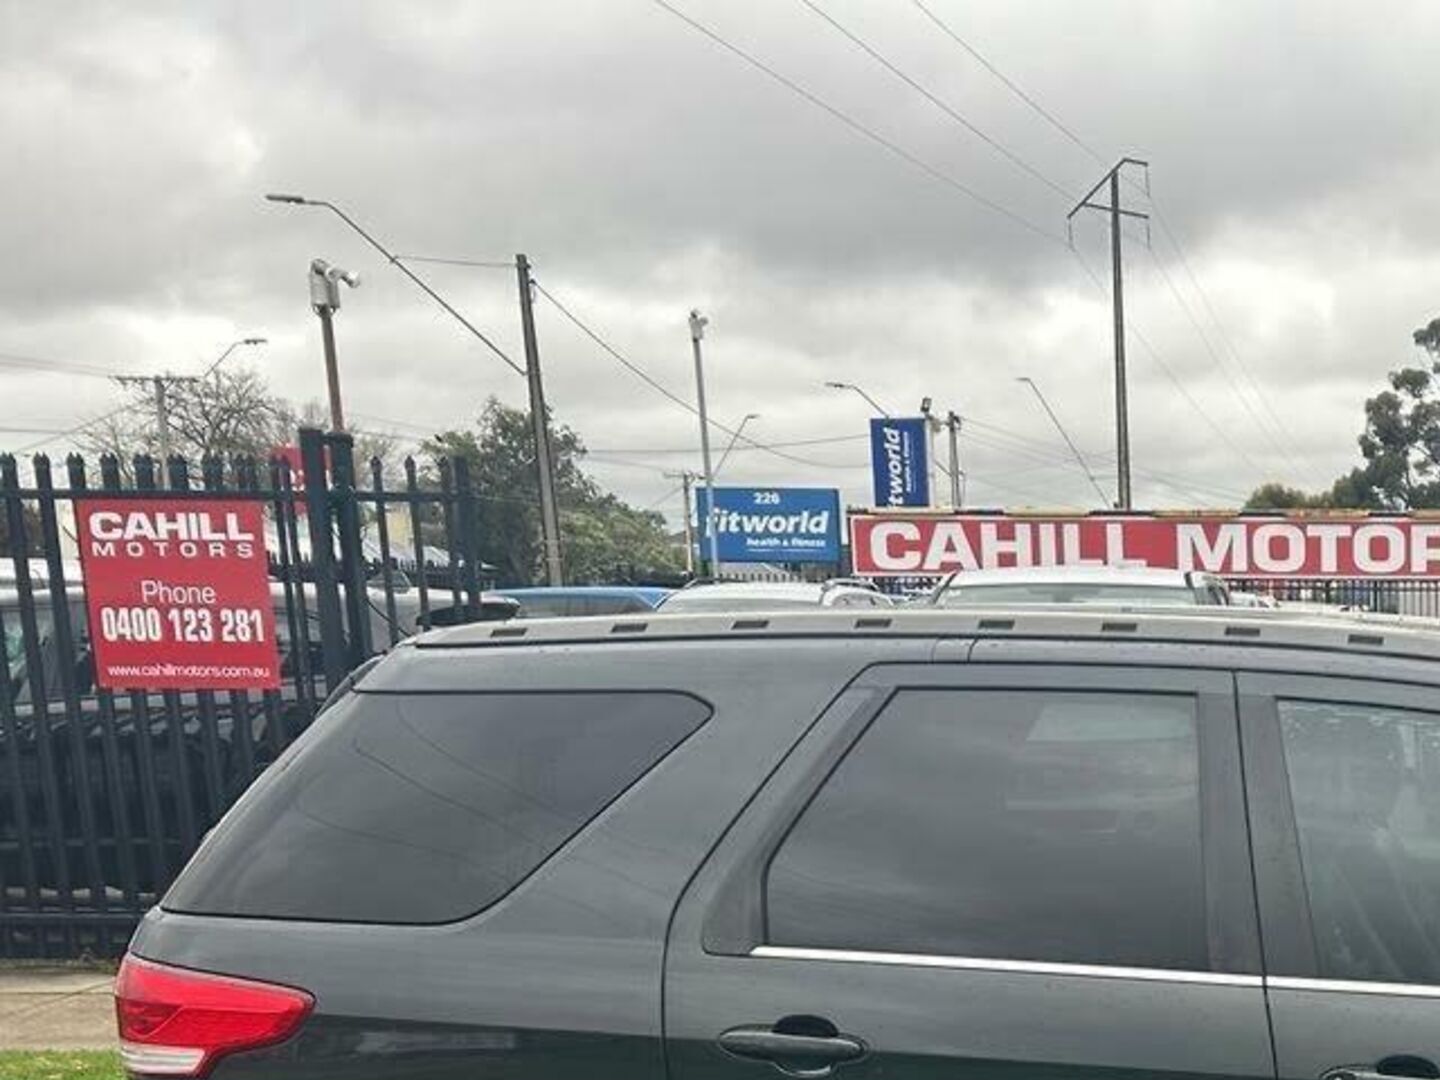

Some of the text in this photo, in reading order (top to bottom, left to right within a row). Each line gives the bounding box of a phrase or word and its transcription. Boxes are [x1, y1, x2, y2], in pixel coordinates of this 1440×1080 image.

[883, 427, 903, 505] tworld
[89, 511, 254, 541] CAHILL
[92, 541, 253, 558] MOTORS
[870, 523, 1146, 570] CAHILL
[141, 579, 217, 605] Phone
[101, 607, 265, 643] 0400 123 281
[107, 662, 270, 679] www.cahillmotors.com.au
